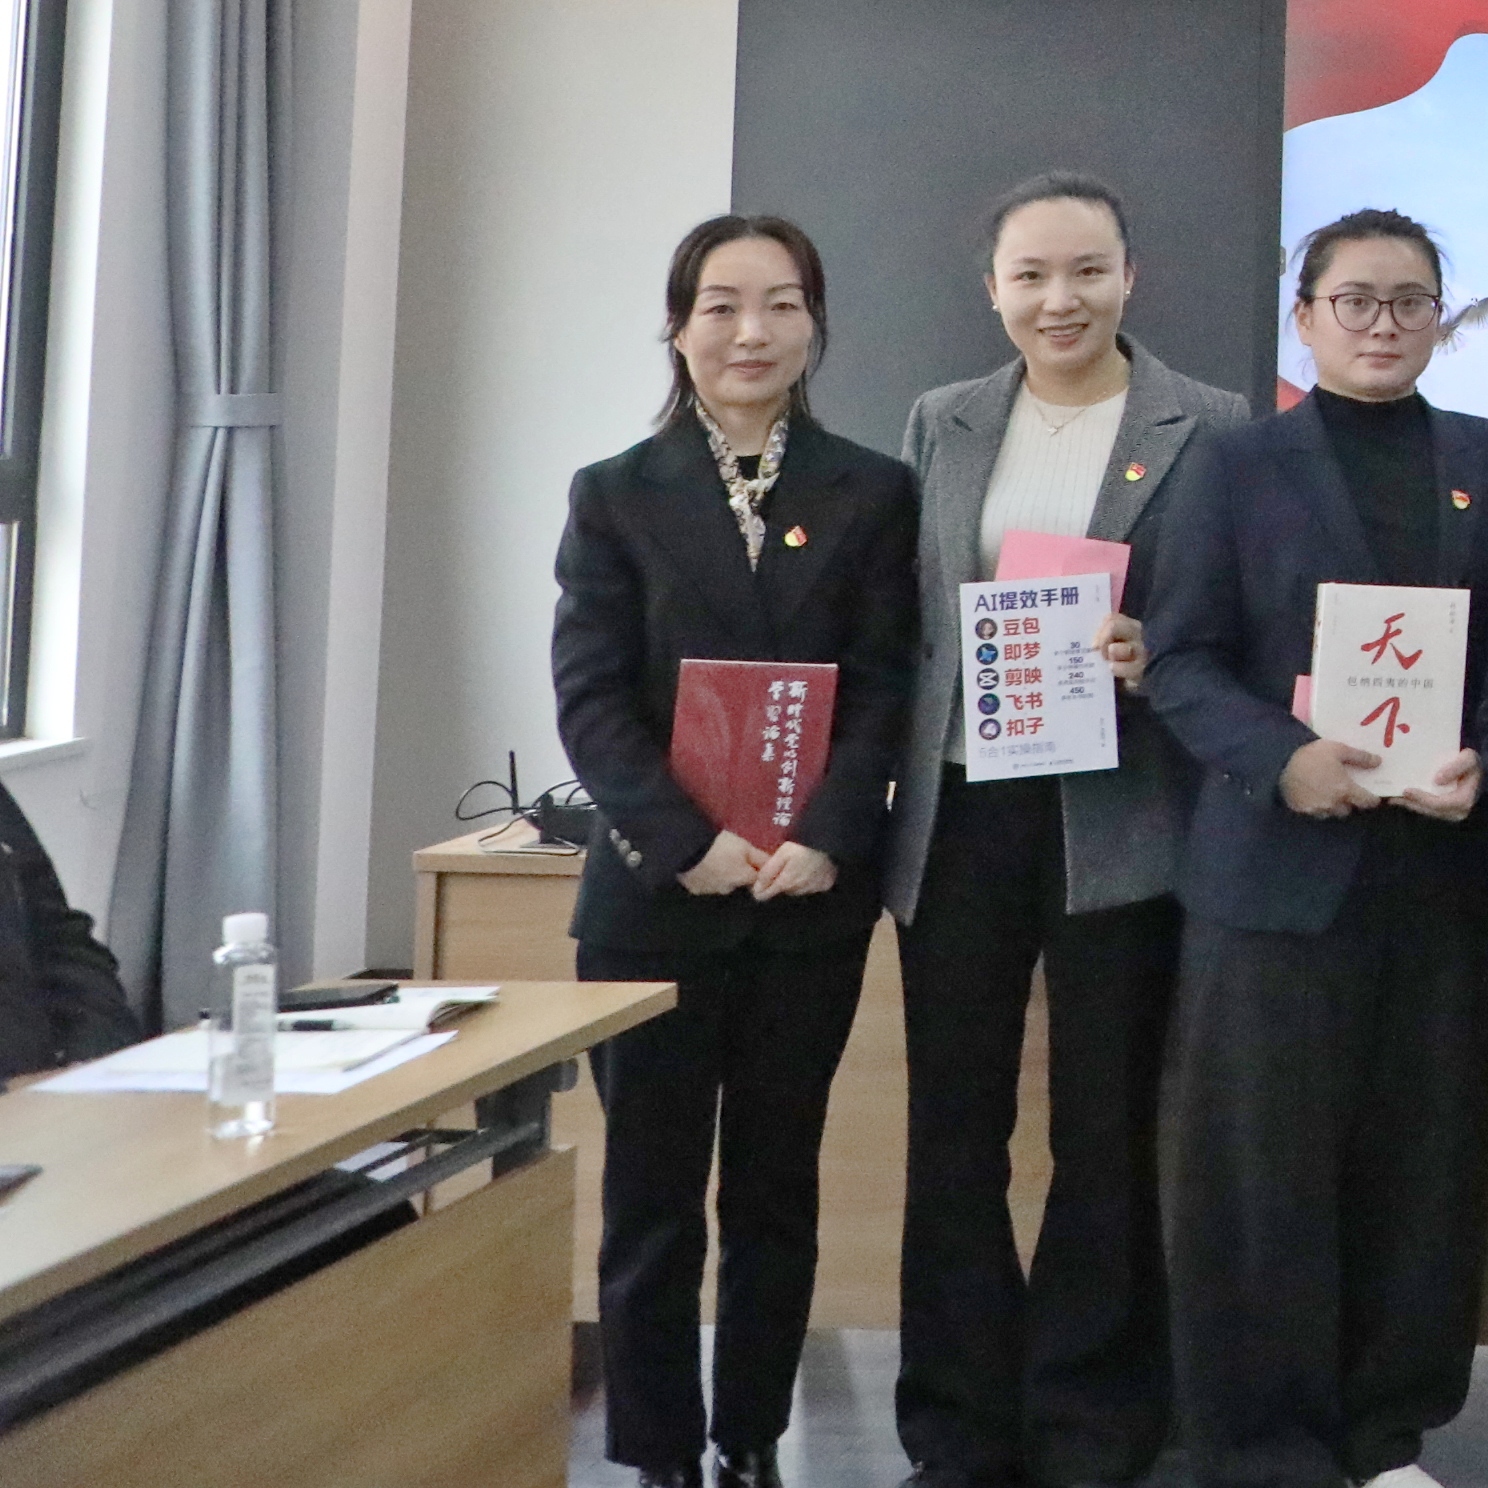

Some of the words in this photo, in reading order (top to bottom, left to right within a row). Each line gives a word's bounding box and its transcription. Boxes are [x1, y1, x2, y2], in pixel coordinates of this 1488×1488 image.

[974, 586, 1079, 613] AI提效手册
[1003, 617, 1040, 636] 豆包
[1004, 642, 1041, 661] 即梦
[1004, 667, 1042, 687] 剪映
[1005, 692, 1043, 710] 飞书
[1006, 717, 1044, 736] 扣子
